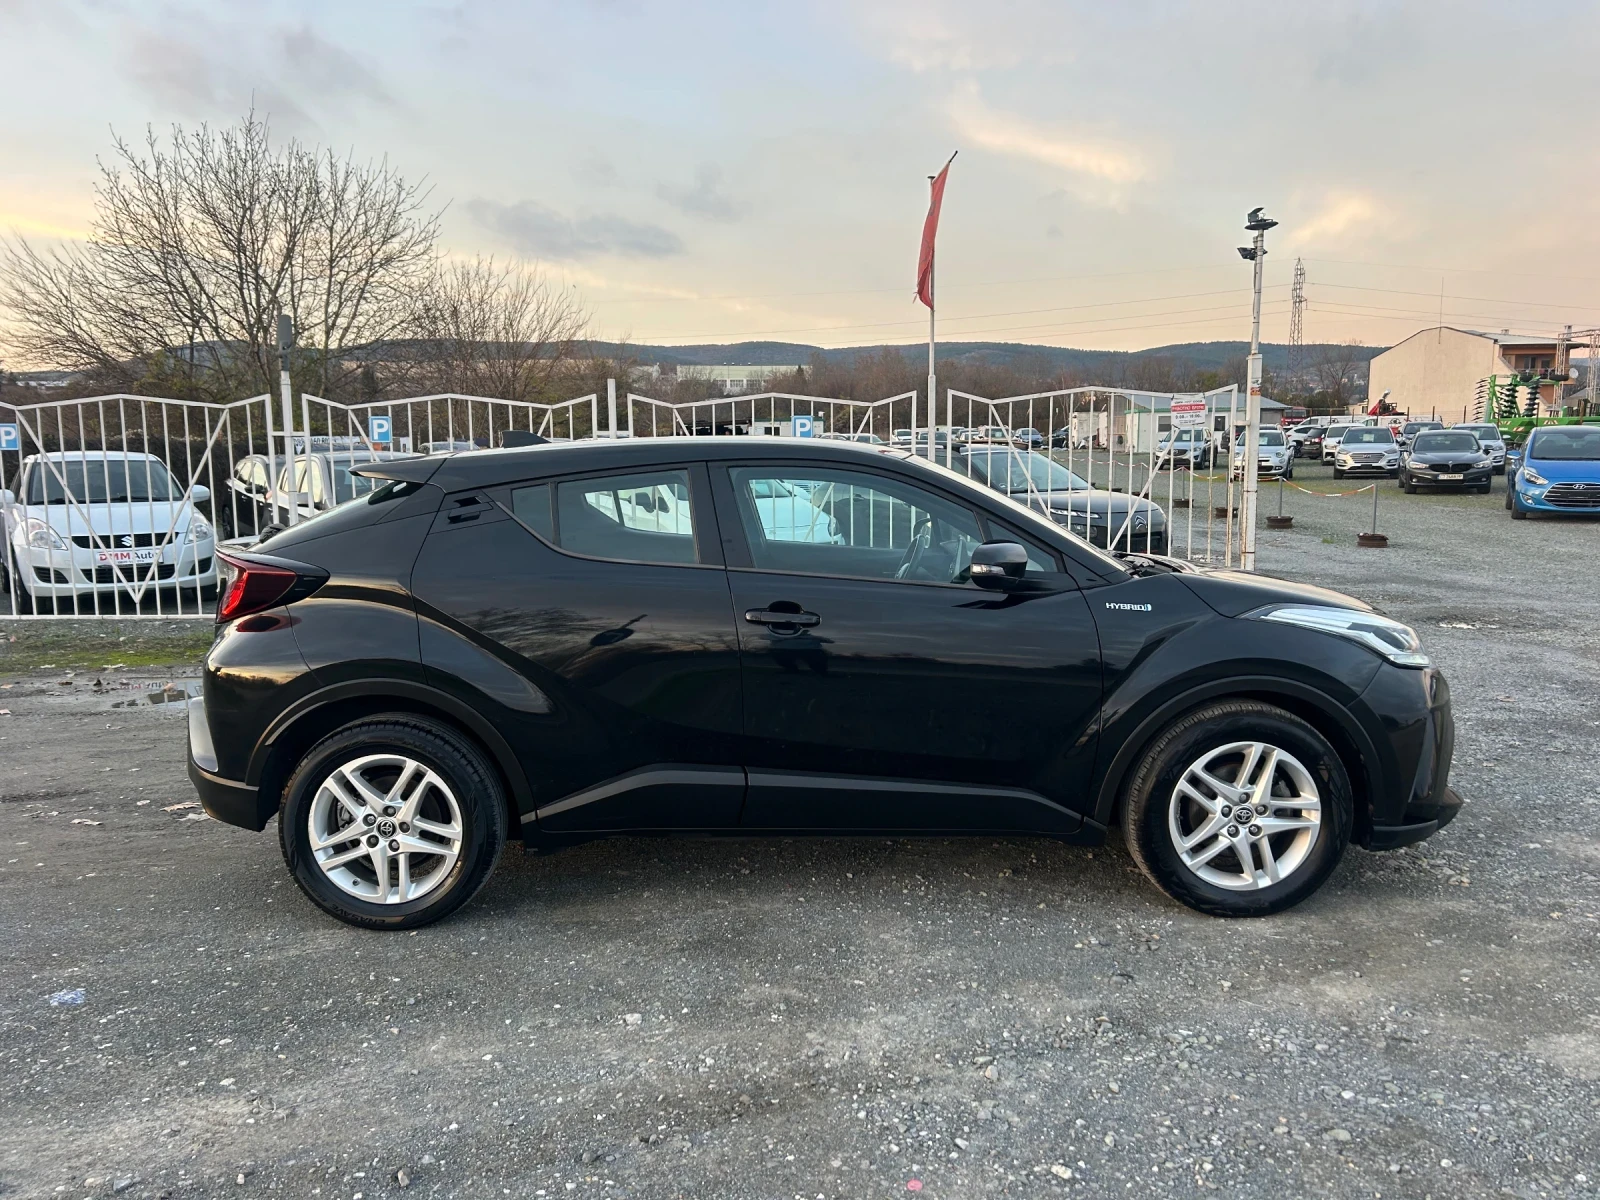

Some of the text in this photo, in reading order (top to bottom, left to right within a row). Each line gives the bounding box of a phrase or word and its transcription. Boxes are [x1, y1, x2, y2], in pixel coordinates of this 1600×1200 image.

[373, 420, 389, 440] P
[796, 418, 811, 436] P
[0, 427, 16, 447] P
[1105, 602, 1145, 611] HYBRID
